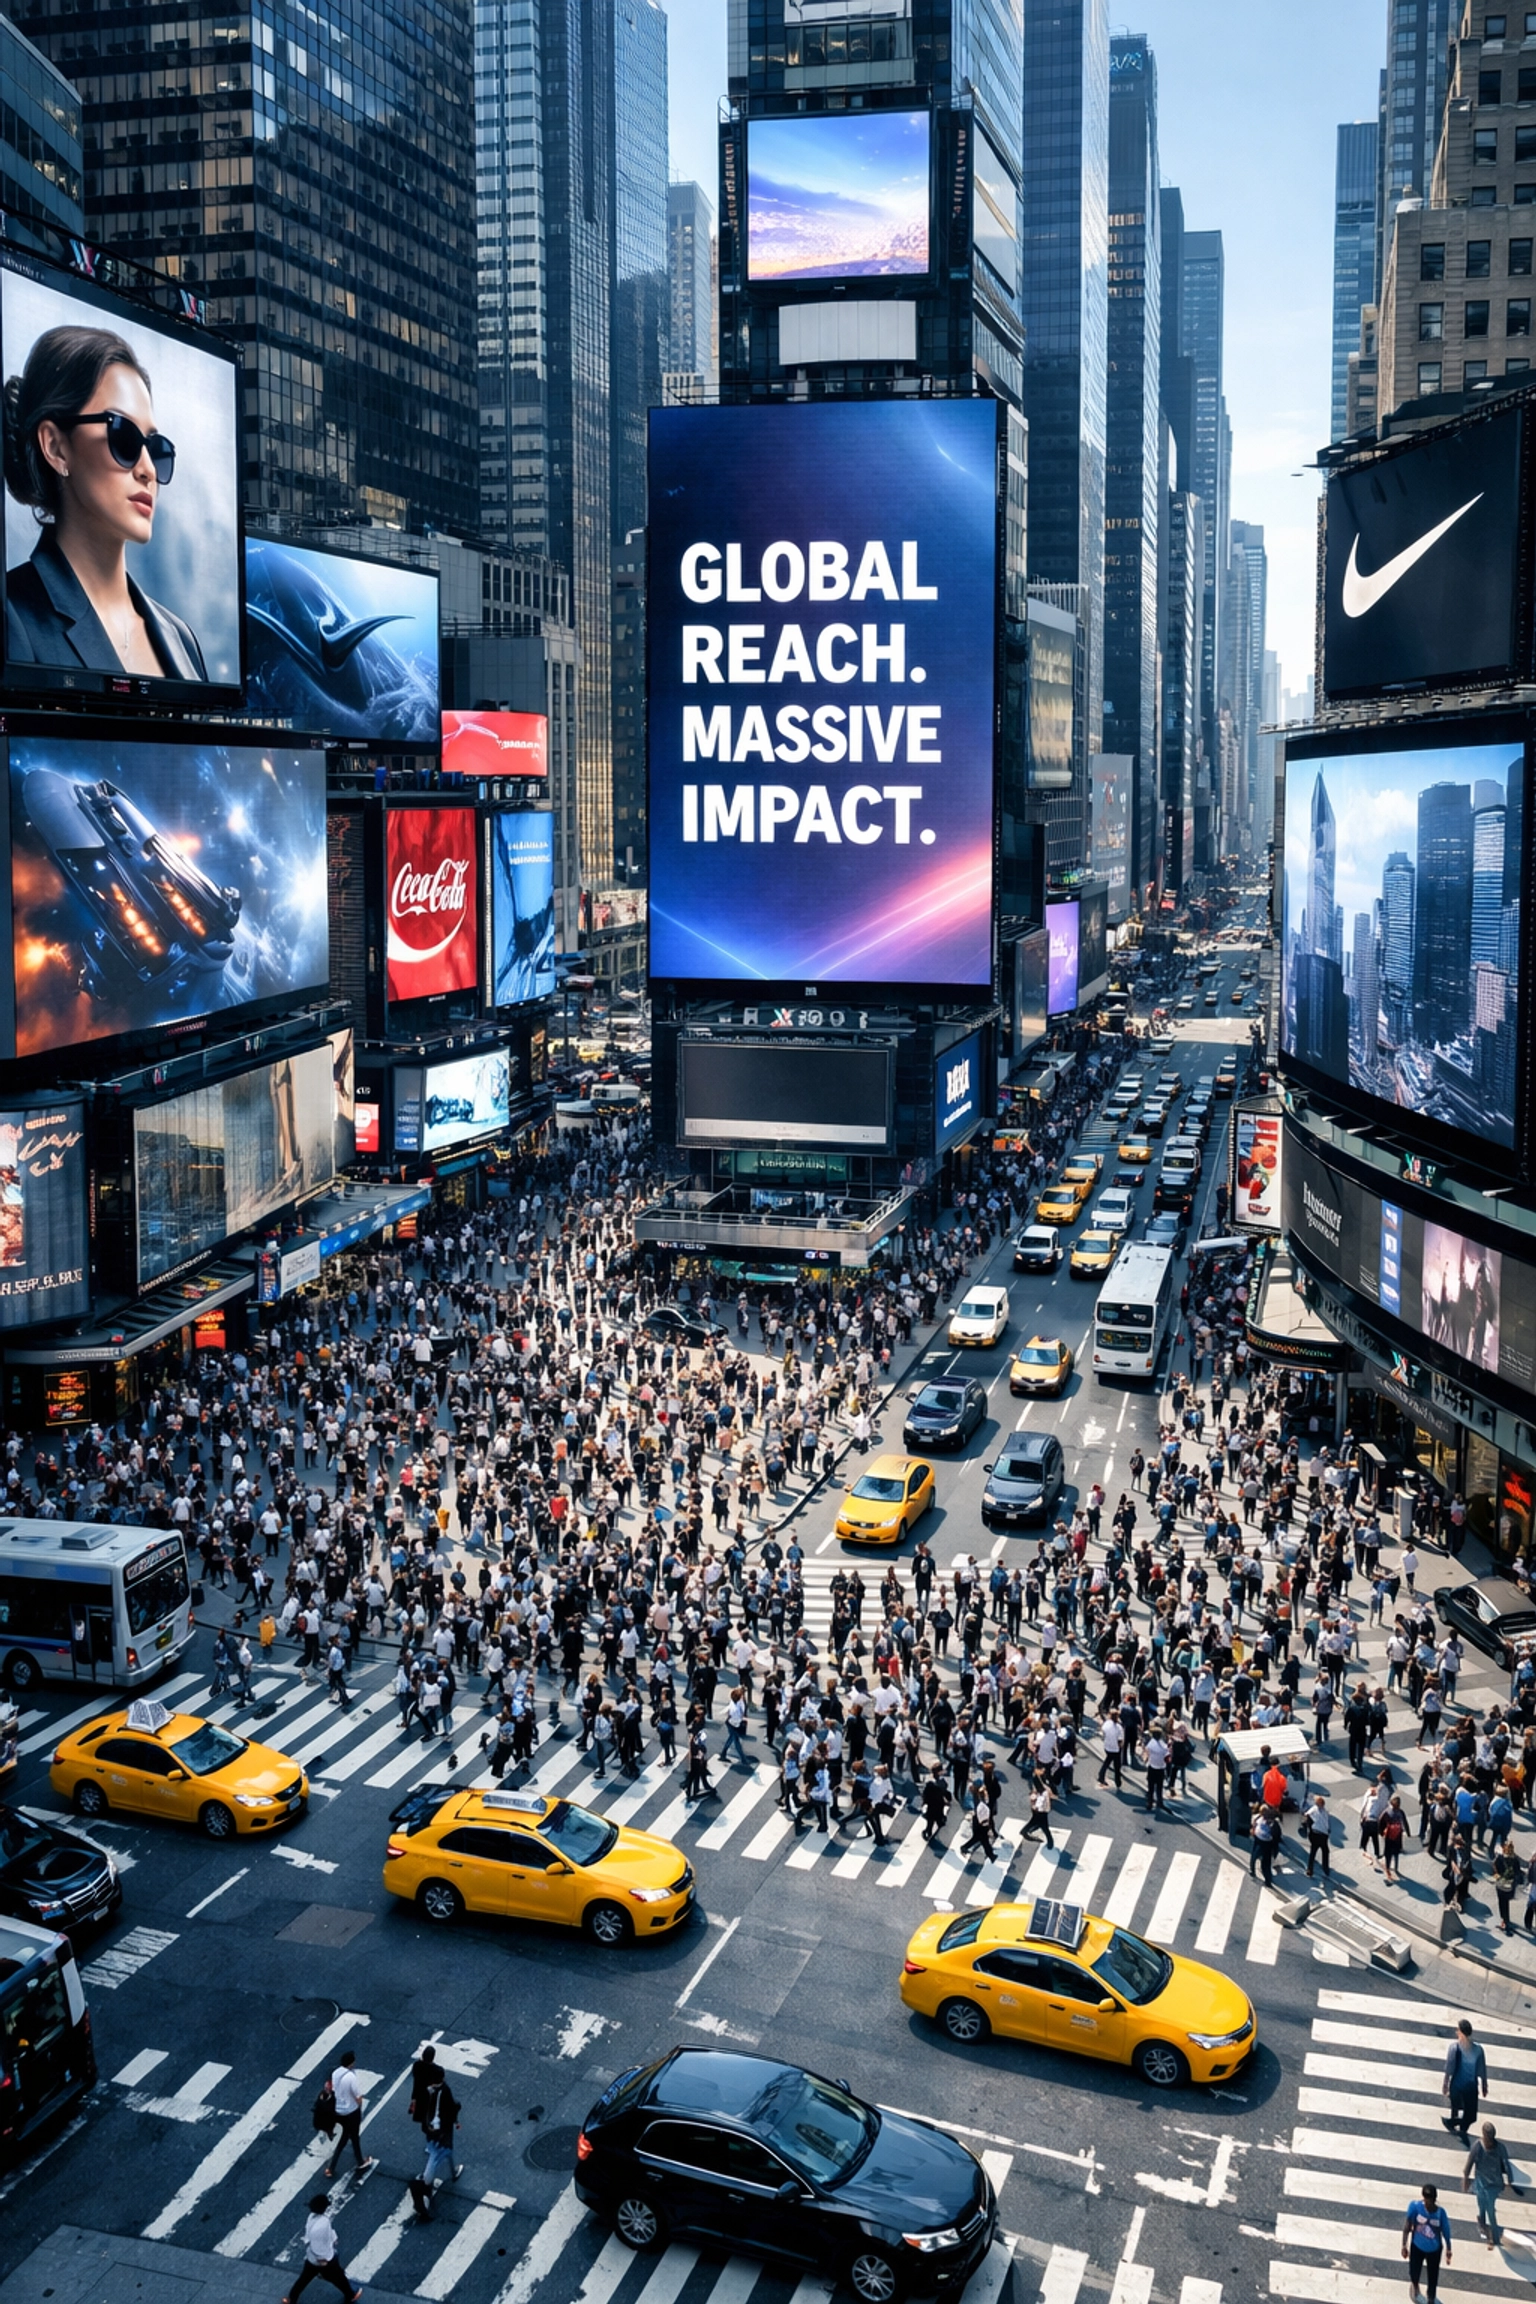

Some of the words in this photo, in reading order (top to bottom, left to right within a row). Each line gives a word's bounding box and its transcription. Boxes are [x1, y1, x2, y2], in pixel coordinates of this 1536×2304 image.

[681, 541, 938, 603] GLOBAL
[681, 622, 927, 685] REACH.
[682, 704, 942, 764] MASSIVE
[682, 784, 936, 846] IMPACT.
